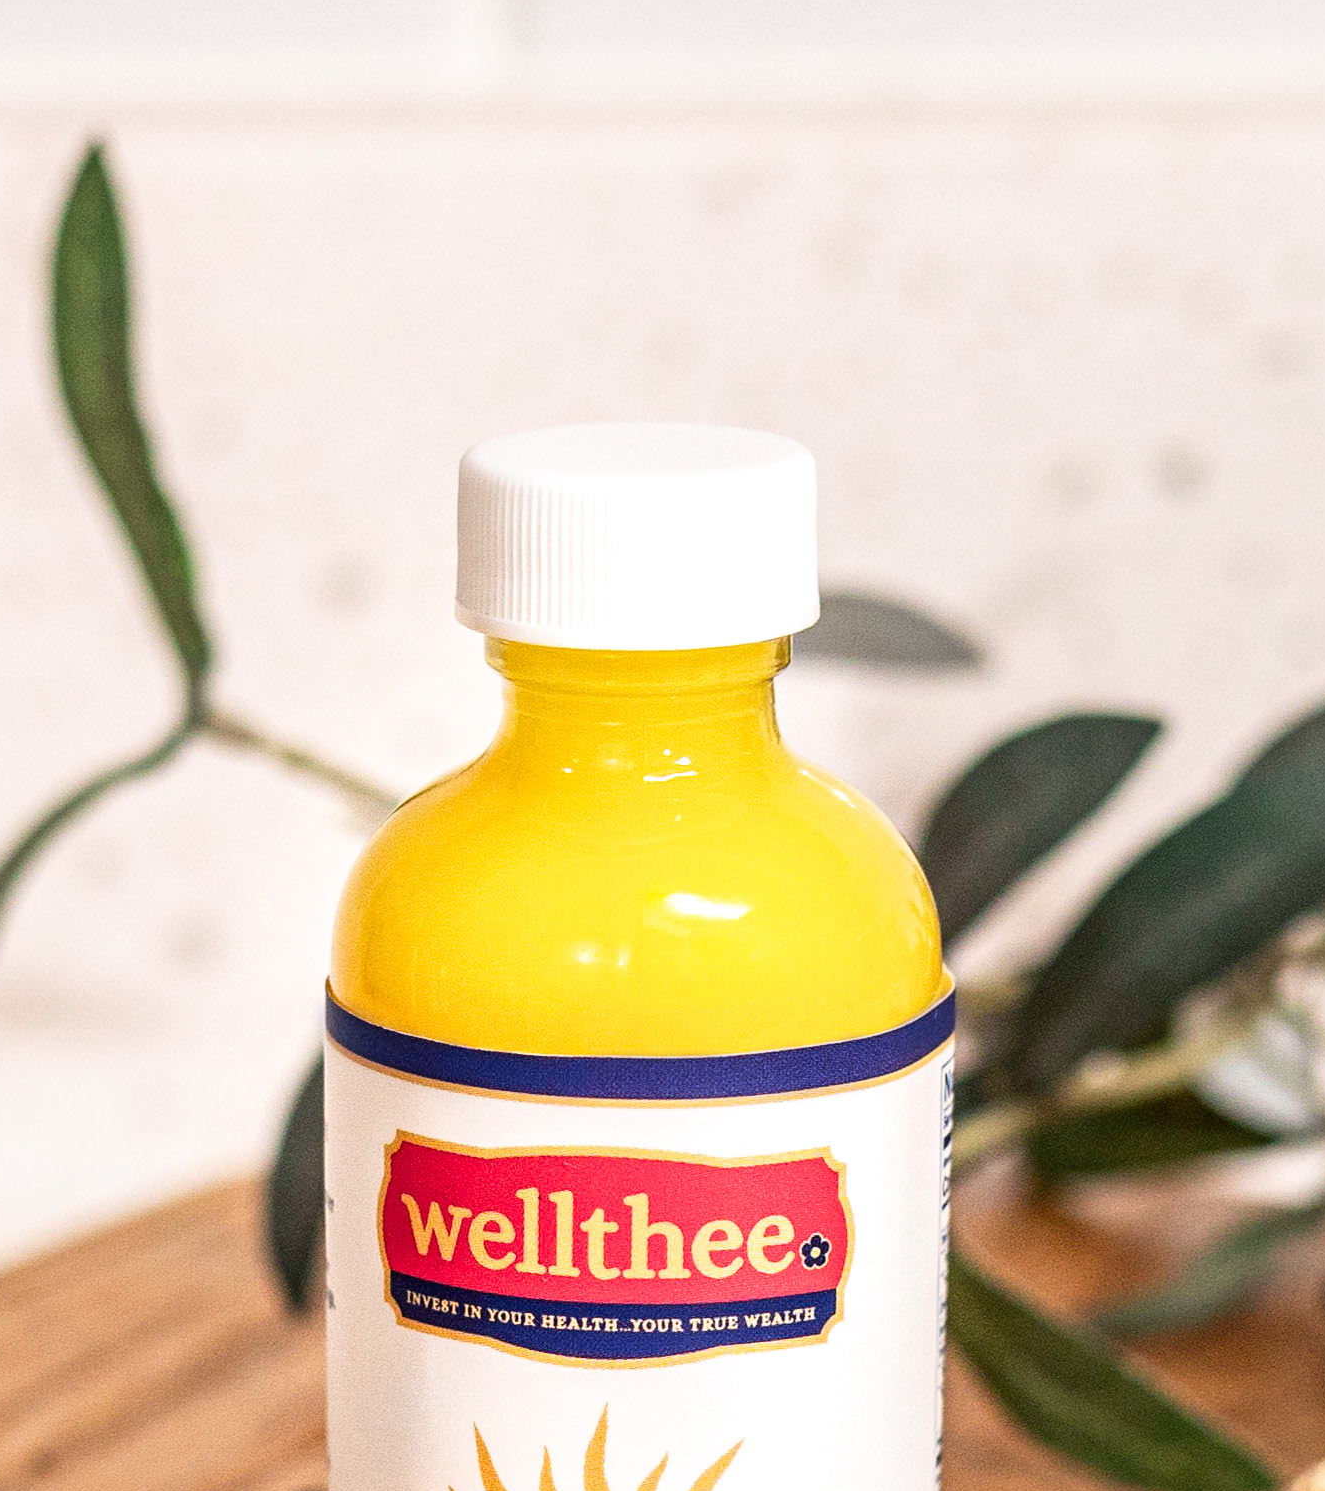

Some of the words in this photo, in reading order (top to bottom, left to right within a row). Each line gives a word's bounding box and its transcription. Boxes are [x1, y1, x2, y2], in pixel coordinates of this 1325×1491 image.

[401, 1187, 795, 1280] wellthee
[406, 1290, 459, 1314] INVEST
[464, 1304, 483, 1319] IN
[487, 1307, 536, 1327] YOUR
[689, 1315, 738, 1332] TRUE
[744, 1306, 817, 1329] WEALTH
